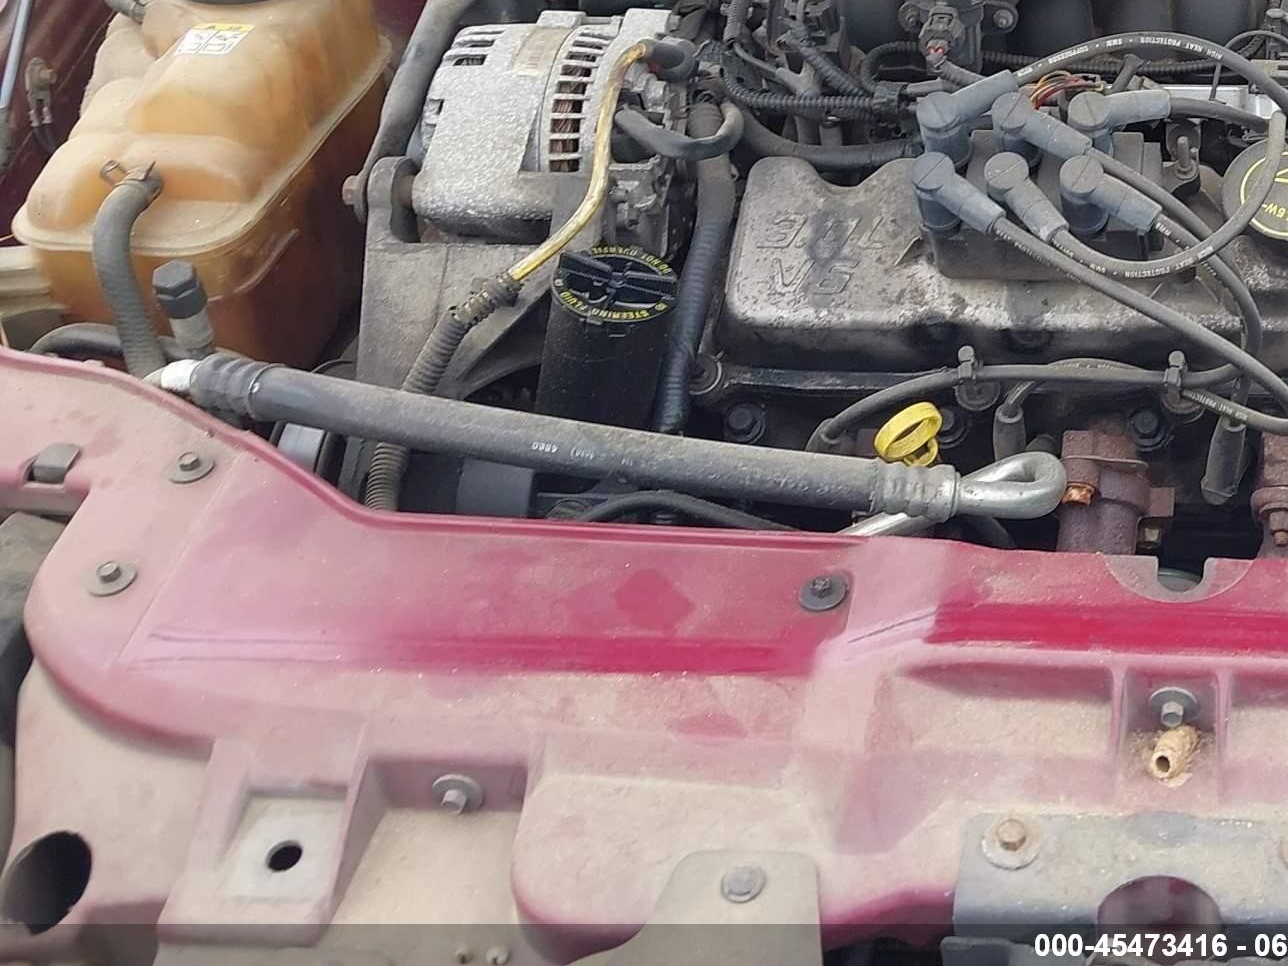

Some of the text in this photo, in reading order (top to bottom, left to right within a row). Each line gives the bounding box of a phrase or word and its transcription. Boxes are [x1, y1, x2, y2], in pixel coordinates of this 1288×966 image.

[1261, 202, 1286, 219] 5W-
[767, 256, 861, 296] V6
[559, 291, 588, 311] FLUID
